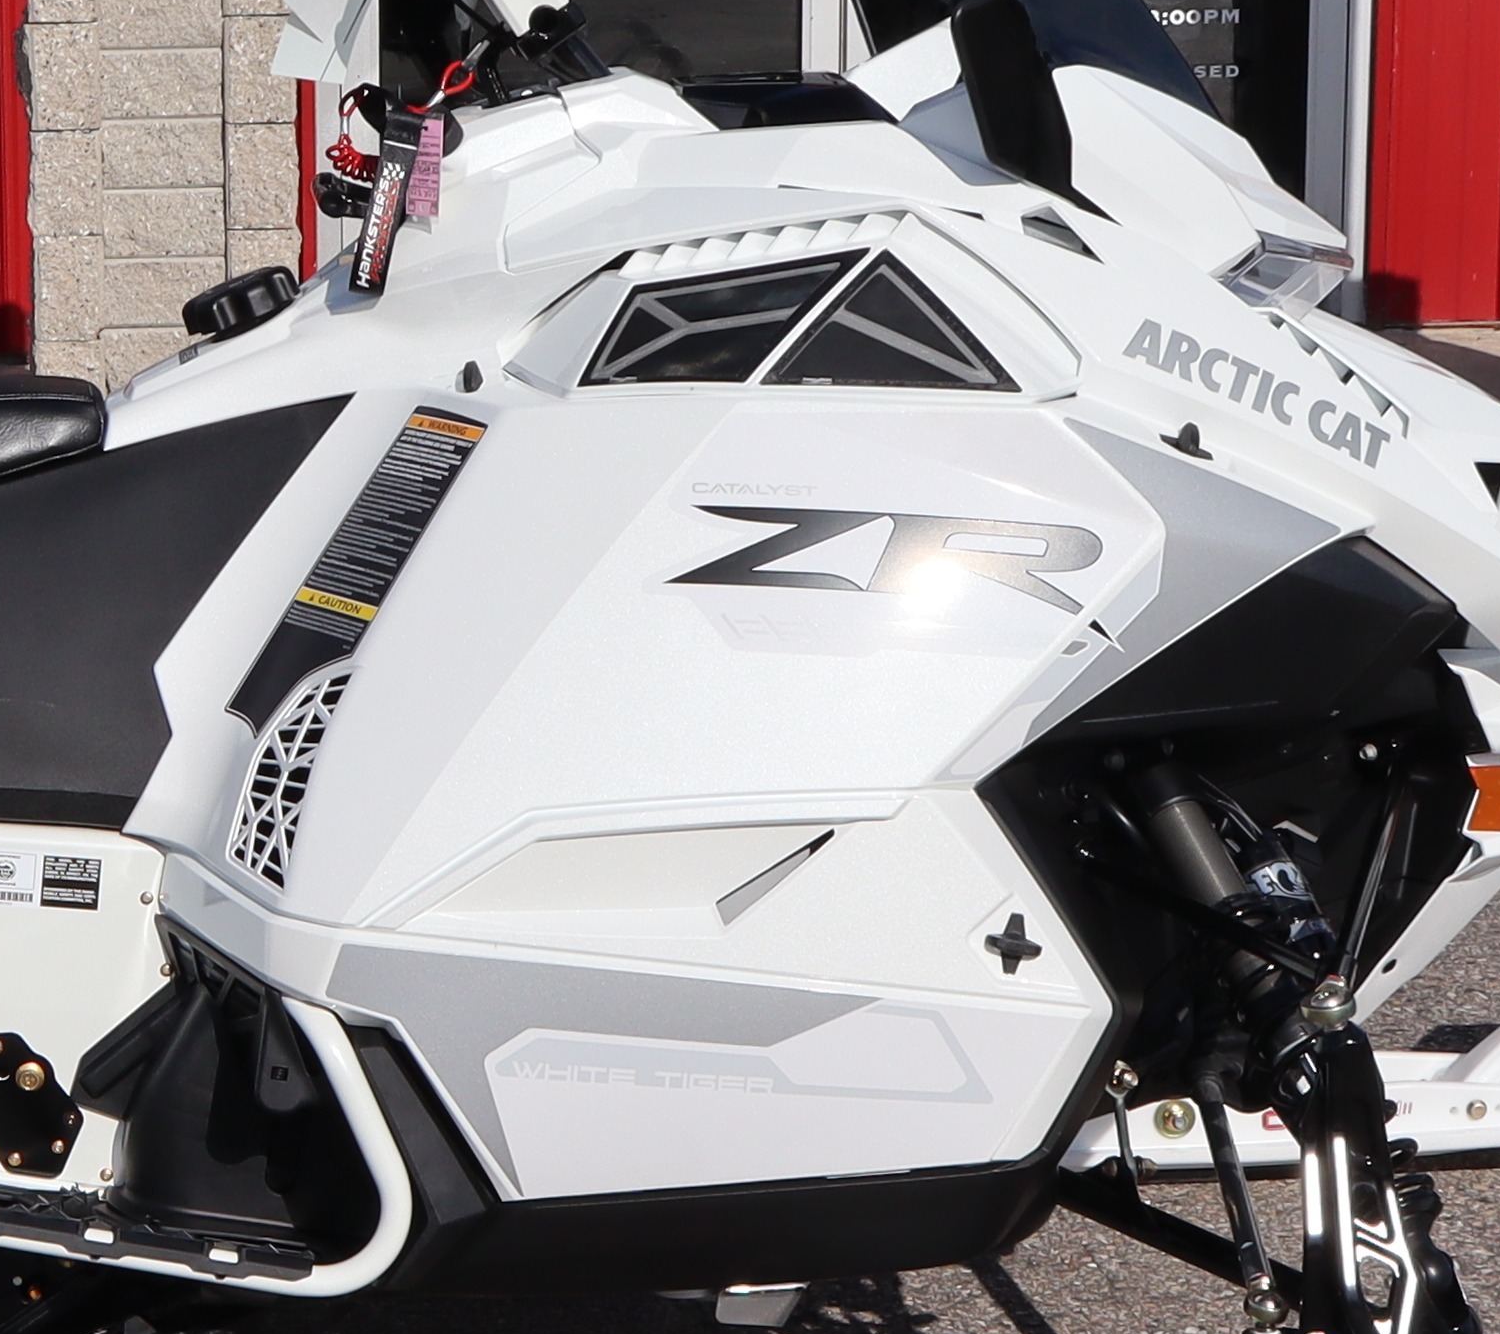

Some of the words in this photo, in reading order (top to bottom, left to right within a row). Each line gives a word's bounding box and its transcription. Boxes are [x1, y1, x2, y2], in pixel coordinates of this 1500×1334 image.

[1121, 318, 1300, 426] ARCTIC
[1308, 399, 1391, 470] CAT
[428, 419, 469, 436] WARNING
[691, 481, 818, 497] CATALYST
[662, 504, 1124, 652] ZR
[318, 595, 362, 614] CAUTION
[1250, 861, 1308, 896] FO
[512, 1060, 636, 1085] WHITE
[654, 1071, 775, 1094] TIGER
